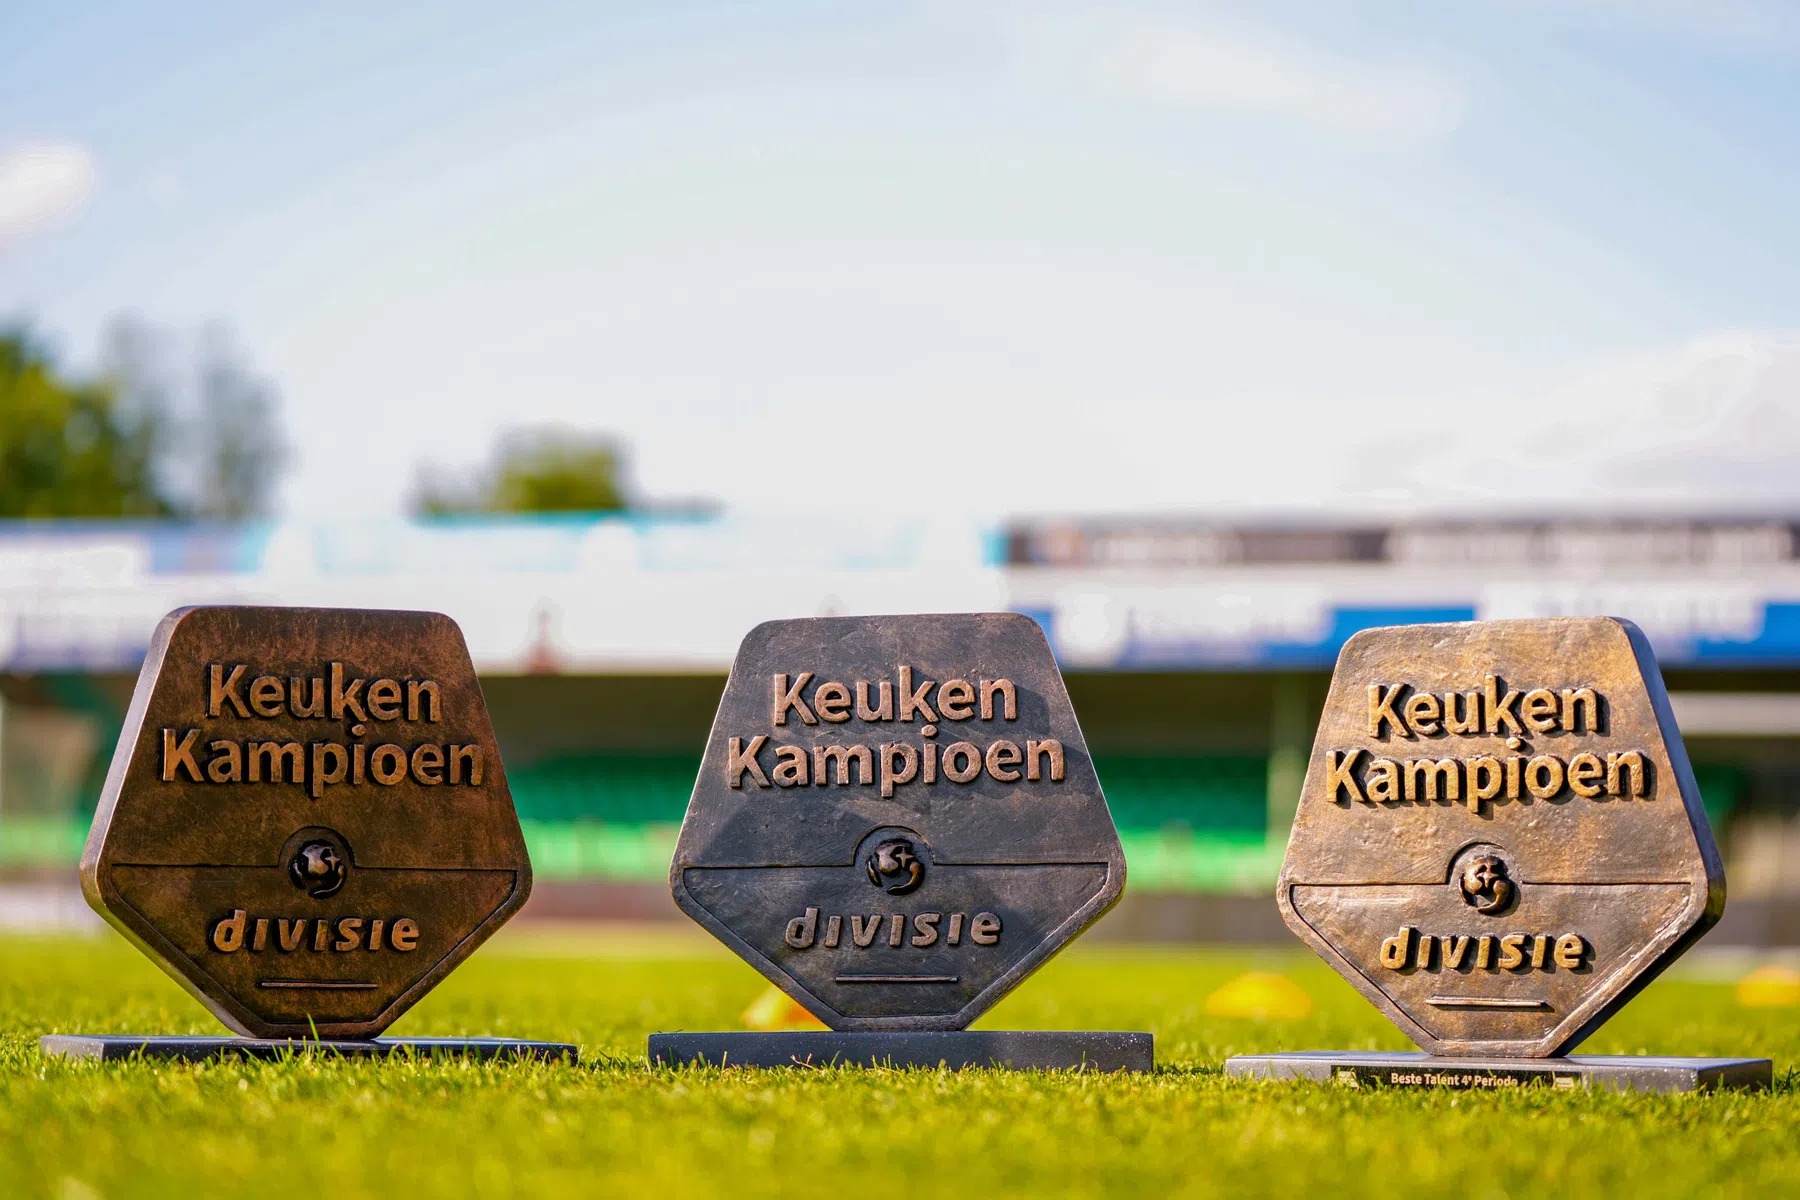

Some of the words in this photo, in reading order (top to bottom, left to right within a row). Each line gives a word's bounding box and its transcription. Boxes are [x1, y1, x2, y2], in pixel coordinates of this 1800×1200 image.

[207, 661, 442, 722] Keuken
[773, 665, 1018, 725] Keuken
[1367, 675, 1601, 738] Keuken
[161, 724, 484, 798] Kampioen
[728, 724, 1065, 798] Kampioen
[1325, 737, 1650, 814] Kampioen
[212, 908, 420, 952] divisie
[784, 907, 1002, 950] divisie
[1379, 925, 1587, 970] divisie
[1391, 1072, 1423, 1085] Beste
[1423, 1073, 1460, 1086] Talent
[1474, 1074, 1519, 1088] Periode
